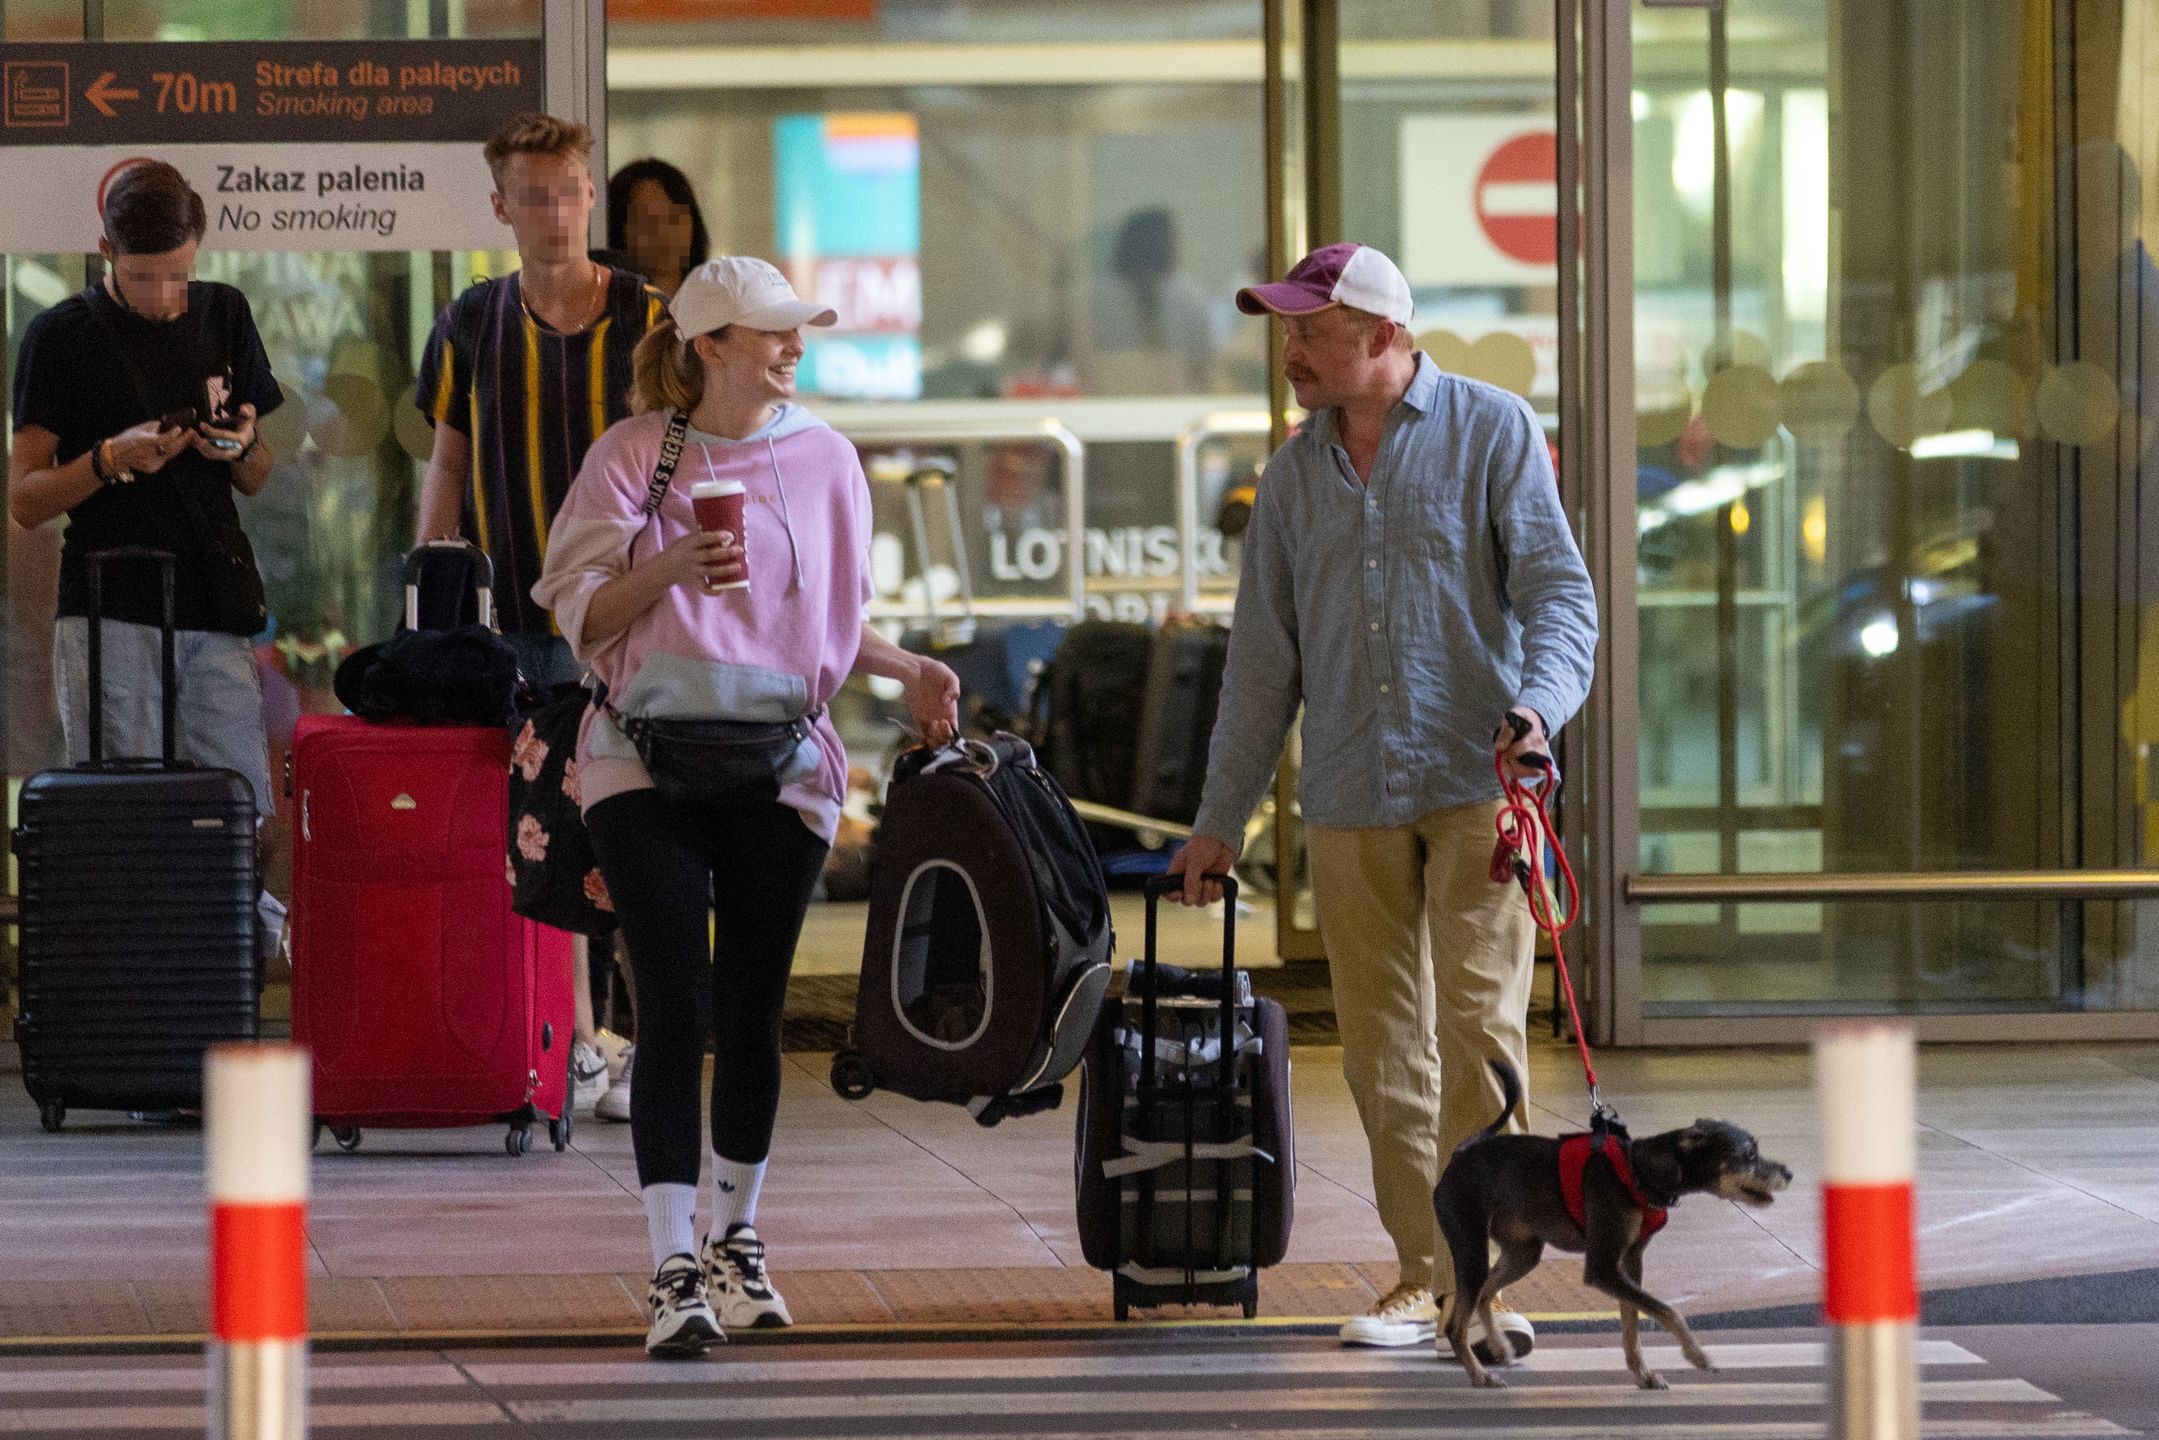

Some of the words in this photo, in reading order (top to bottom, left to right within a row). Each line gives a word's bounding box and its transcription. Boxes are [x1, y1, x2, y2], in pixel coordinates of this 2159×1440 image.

[255, 61, 338, 88] Strefa
[349, 61, 389, 87] dla
[400, 60, 521, 92] palących
[153, 72, 238, 114] 70m
[255, 93, 368, 121] Smoking
[377, 95, 434, 115] area
[217, 166, 306, 193] Zakaz
[317, 164, 426, 197] palenia
[218, 203, 261, 231] No
[271, 203, 397, 236] smoking
